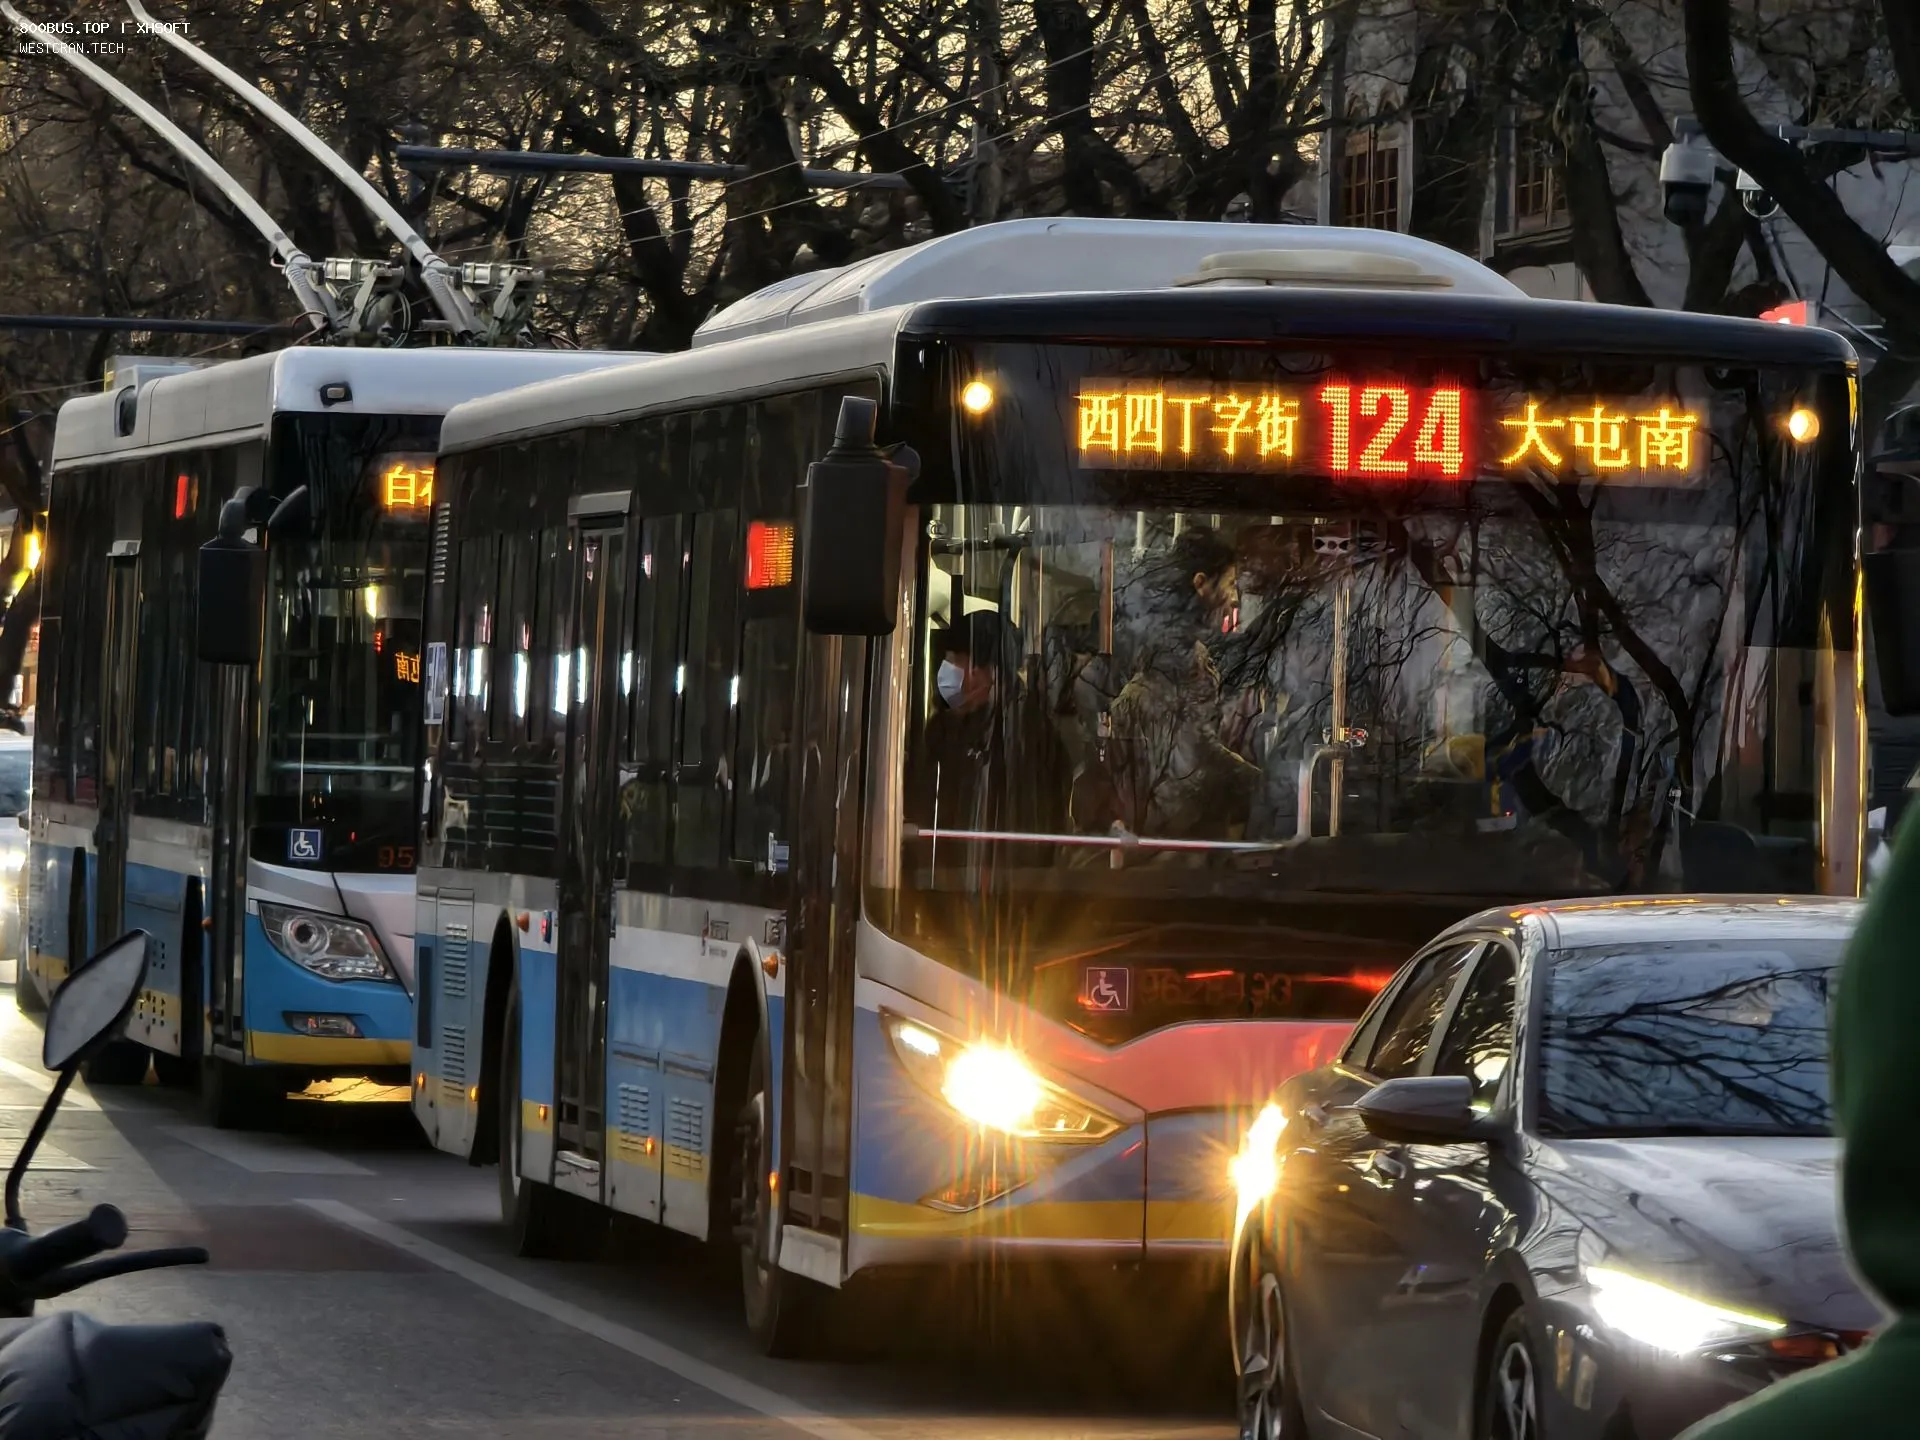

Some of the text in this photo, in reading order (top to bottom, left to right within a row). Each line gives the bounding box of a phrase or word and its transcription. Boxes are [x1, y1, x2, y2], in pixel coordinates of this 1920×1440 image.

[1074, 383, 1701, 476] 西四丁字街 124 大屯南
